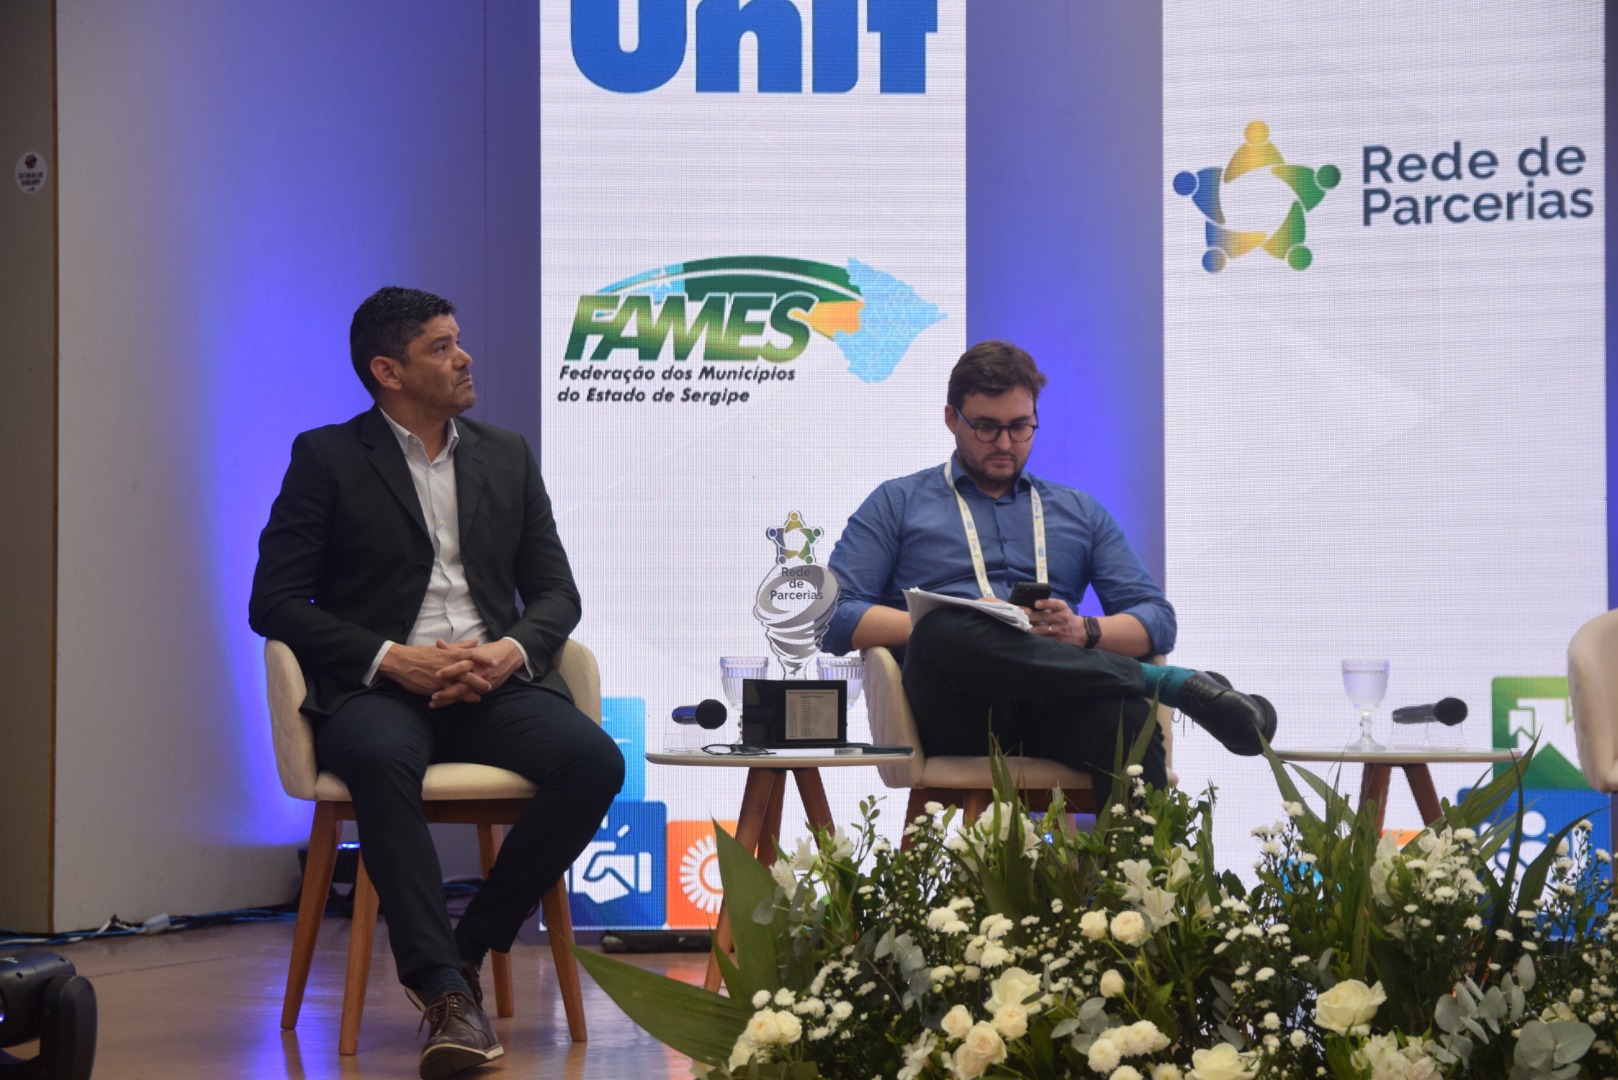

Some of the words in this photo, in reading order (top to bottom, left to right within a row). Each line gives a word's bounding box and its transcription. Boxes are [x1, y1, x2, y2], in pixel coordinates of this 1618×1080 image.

[1362, 140, 1499, 185] Rede
[1518, 136, 1587, 177] de
[1362, 180, 1595, 226] Parcerias
[564, 292, 817, 363] FAMES
[559, 365, 656, 384] Federação
[661, 365, 692, 380] dos
[698, 365, 796, 384] Municípios
[557, 387, 580, 402] do
[586, 387, 645, 402] Estado
[652, 387, 675, 402] de
[680, 387, 750, 406] Sergipe
[781, 566, 811, 577] Rede
[789, 578, 804, 588] de
[770, 589, 823, 600] Parcerias
